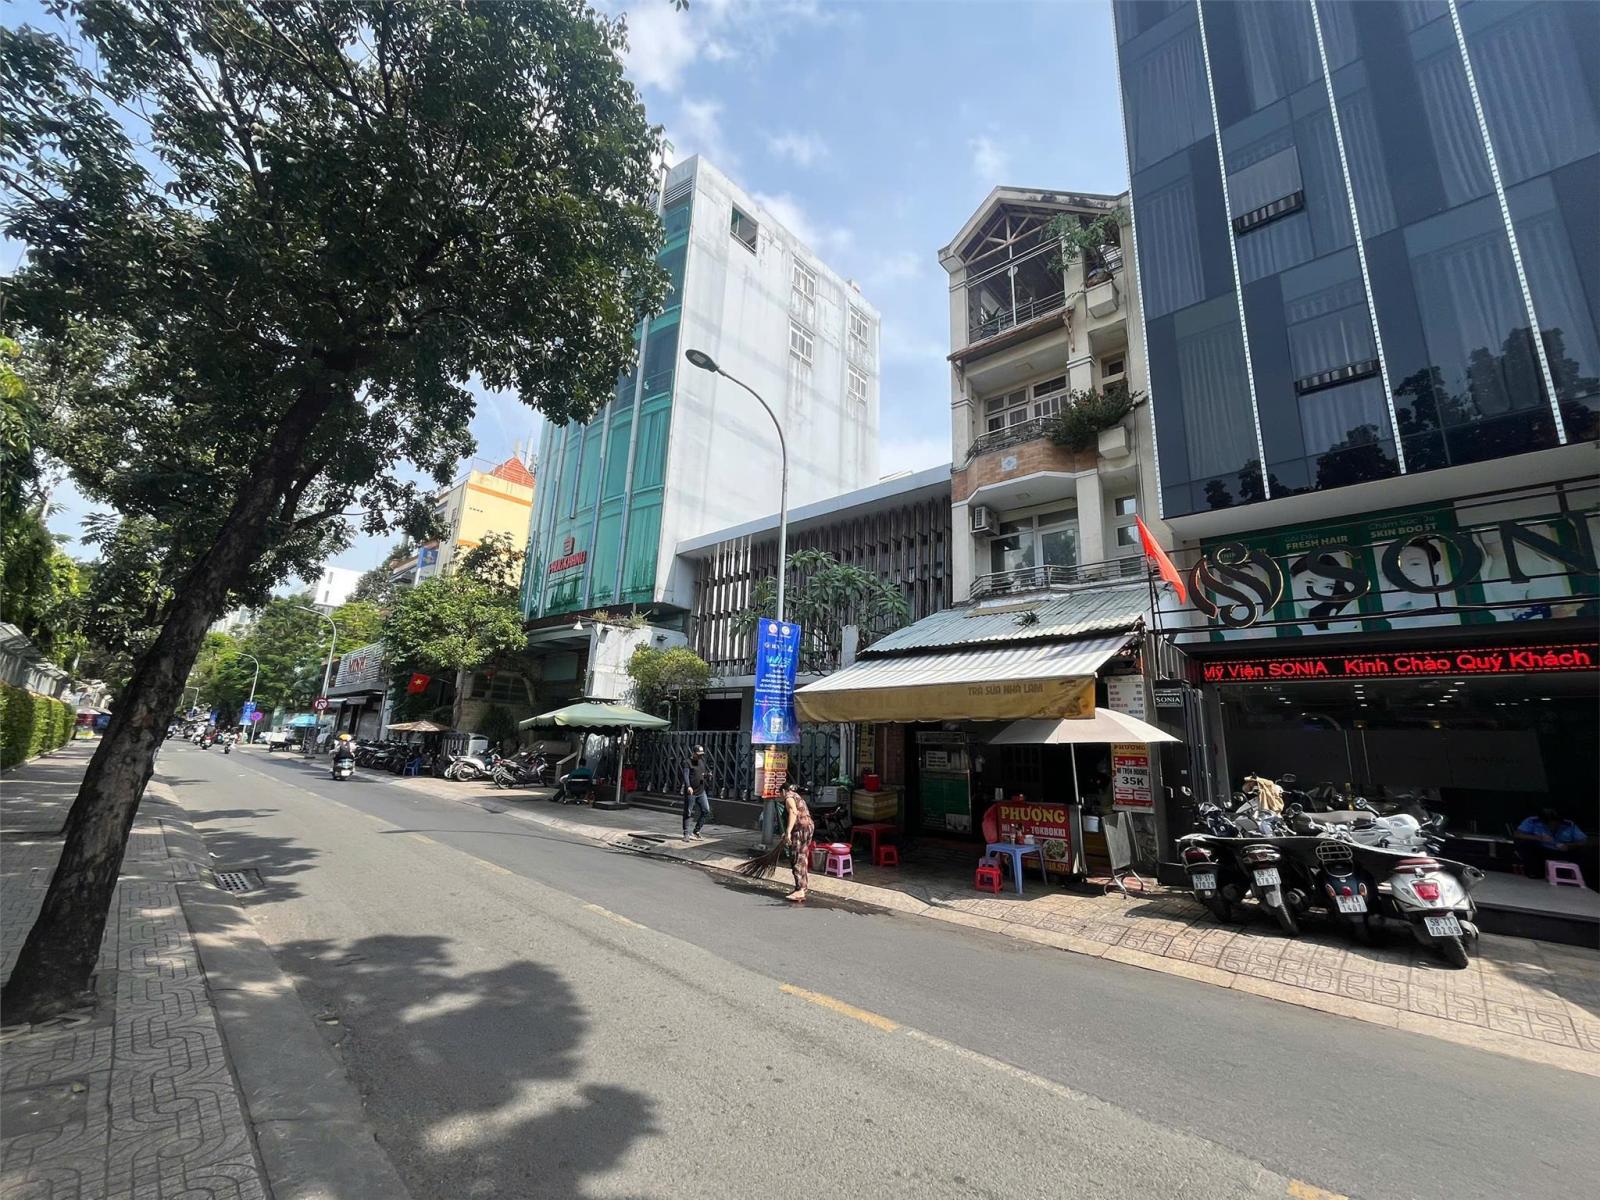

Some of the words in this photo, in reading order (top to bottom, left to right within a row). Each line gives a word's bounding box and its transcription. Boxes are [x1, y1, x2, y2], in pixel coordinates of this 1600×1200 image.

[1370, 528, 1396, 539] SKIN
[1398, 522, 1438, 534] BOOST
[1285, 539, 1319, 550] FRESH
[1320, 535, 1348, 545] HAIR
[1227, 664, 1264, 679] Viện
[1268, 660, 1328, 676] SONIA
[1393, 655, 1451, 672] Chào
[1456, 653, 1503, 671] Quý
[1509, 650, 1590, 669] Khách
[1121, 776, 1144, 786] 35K
[1000, 806, 1066, 825] PHƯỢNG
